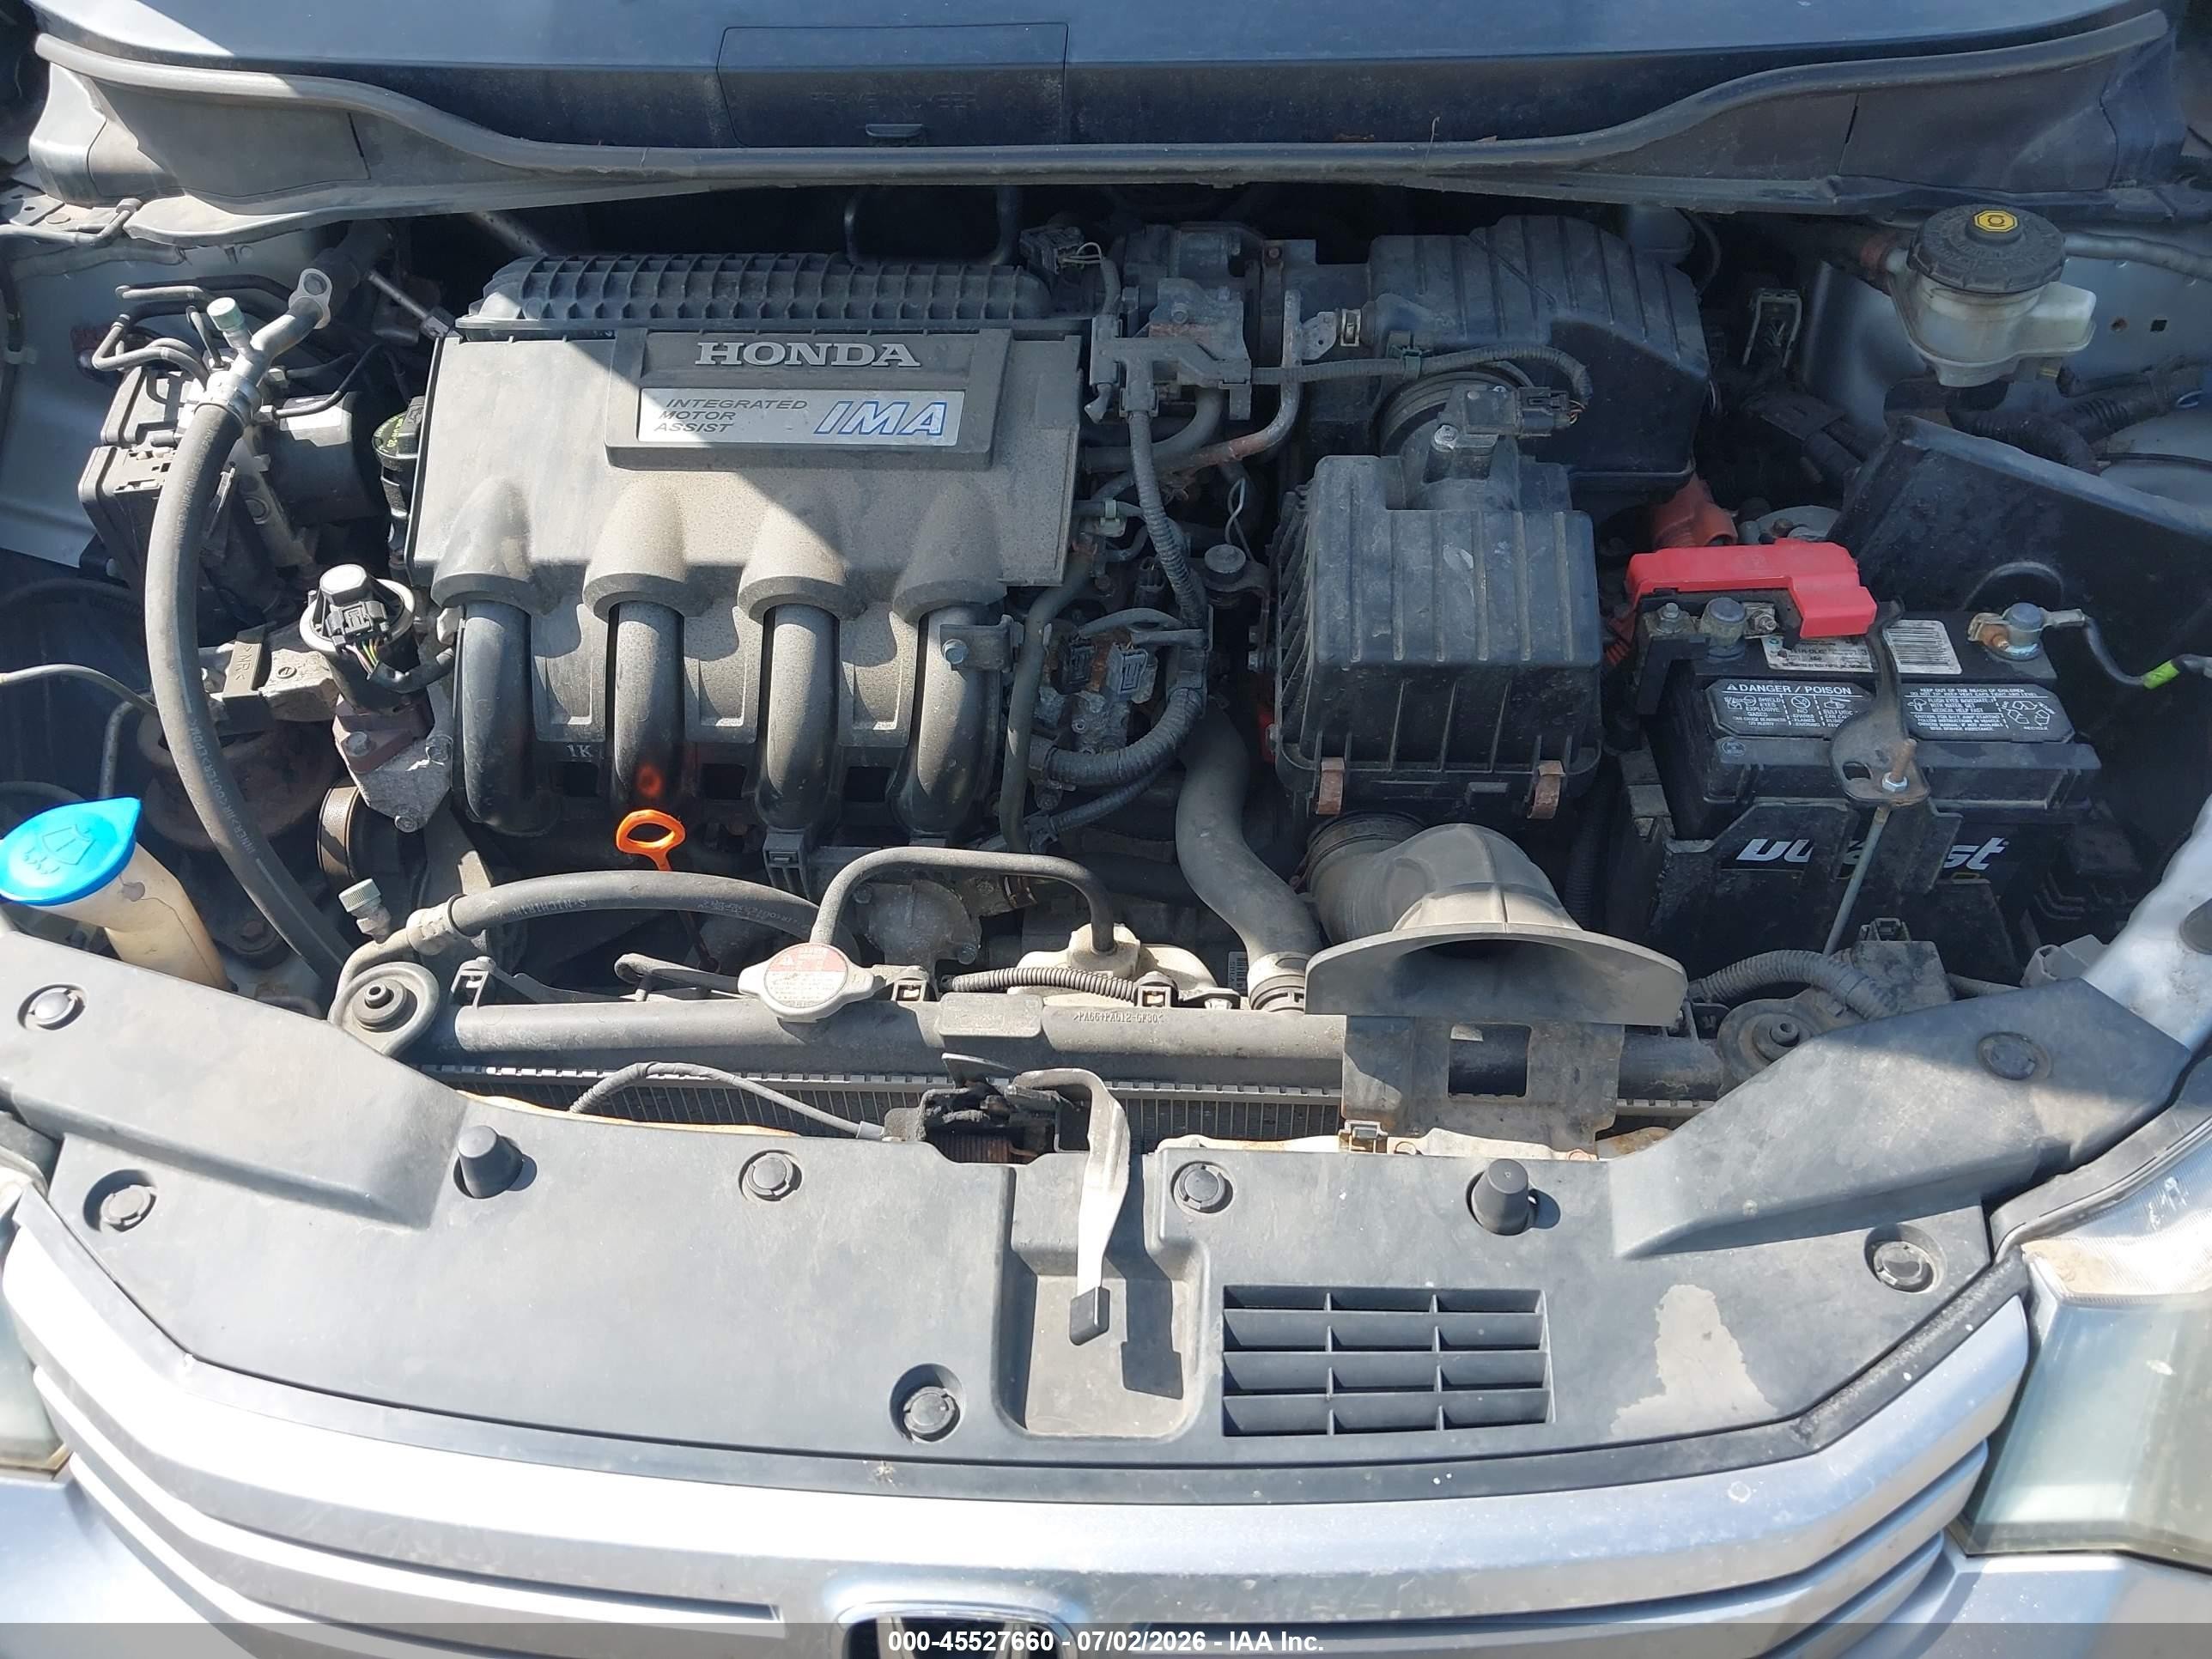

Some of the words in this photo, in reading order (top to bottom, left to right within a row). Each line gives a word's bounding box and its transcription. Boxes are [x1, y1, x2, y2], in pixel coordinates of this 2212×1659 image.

[696, 342, 921, 368] HONDA
[665, 398, 808, 410] INTEGRATED
[658, 410, 737, 421] MOTOR
[813, 400, 948, 436] IMA
[653, 422, 734, 433] ASSIST
[1739, 684, 1792, 693] DANGER
[1805, 686, 1852, 695] POISON
